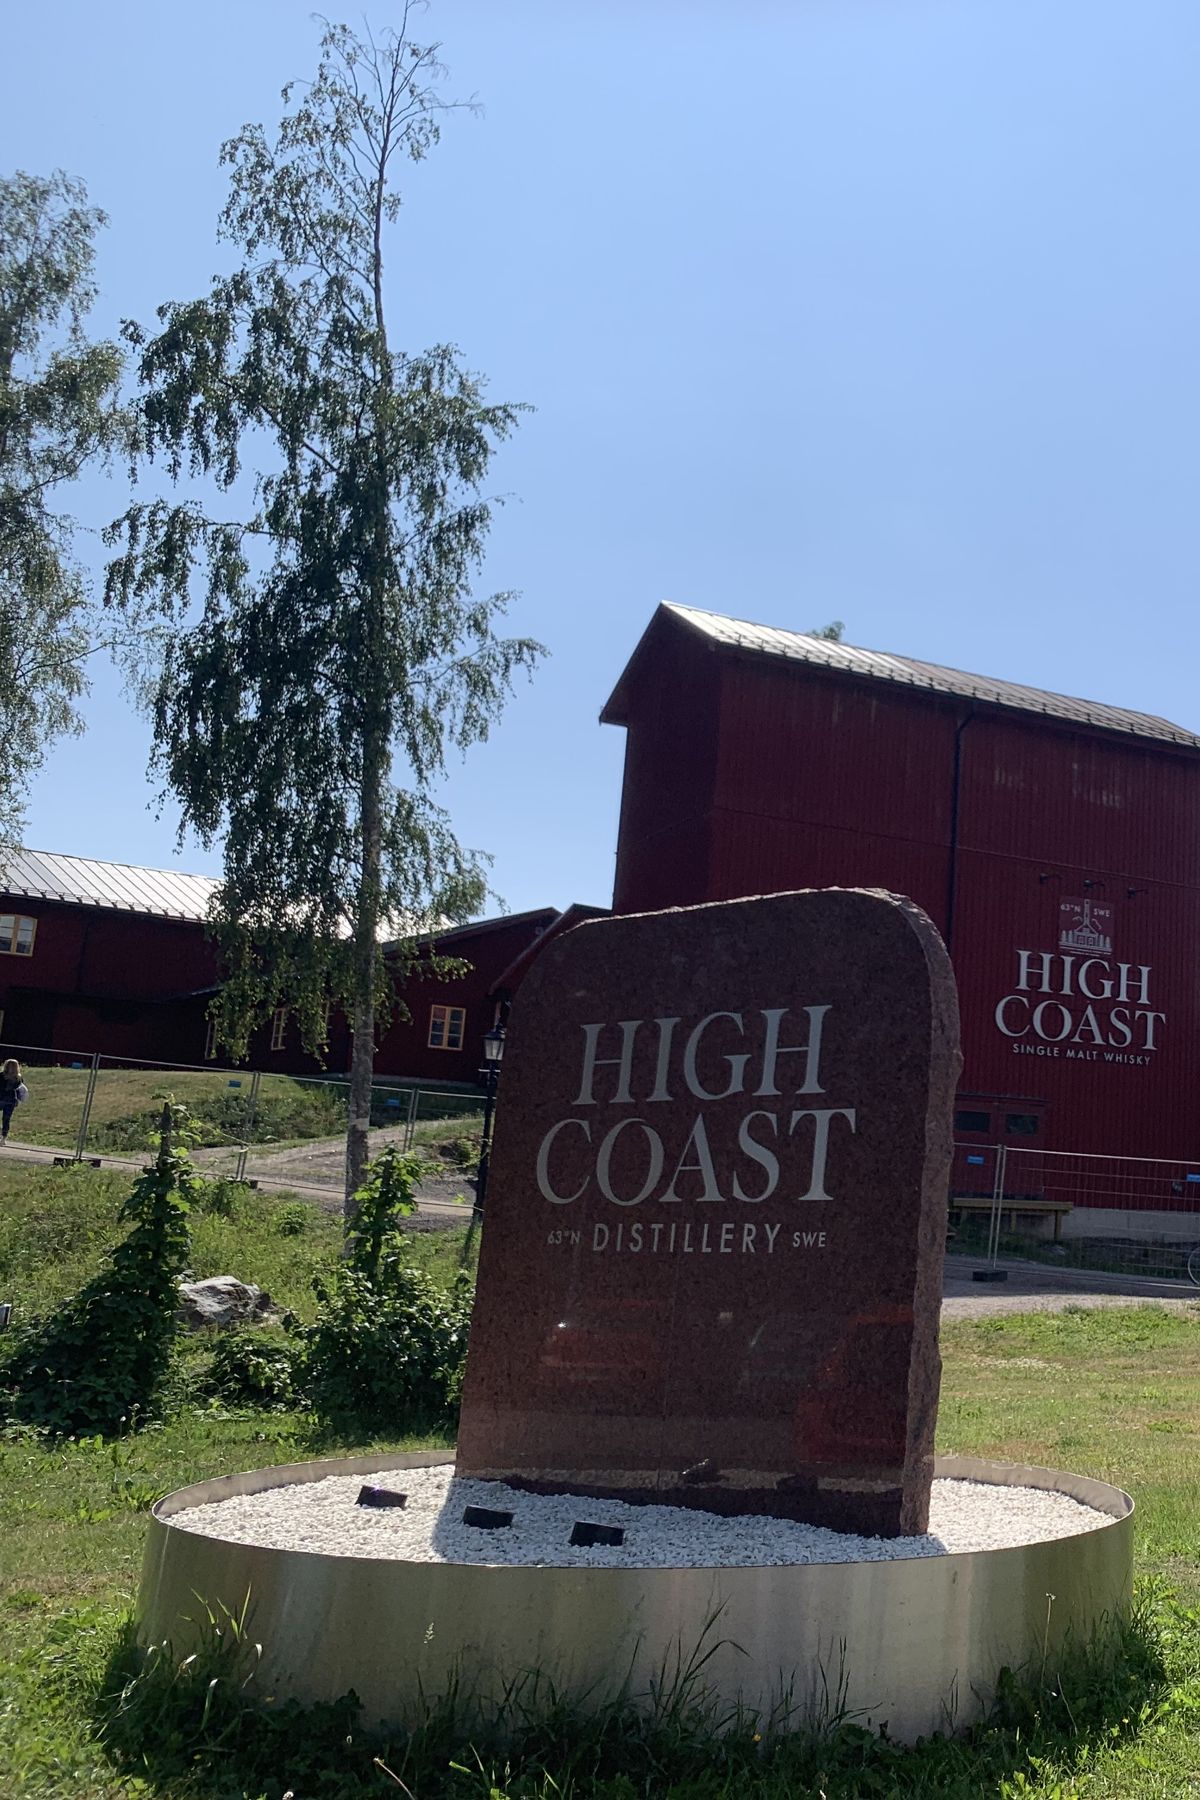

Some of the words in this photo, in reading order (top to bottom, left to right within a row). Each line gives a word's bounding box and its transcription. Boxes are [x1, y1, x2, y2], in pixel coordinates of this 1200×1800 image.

[1093, 908, 1110, 917] SWE
[1015, 949, 1152, 1005] HIGH
[995, 995, 1166, 1050] COAST
[571, 1004, 833, 1105] HIGH
[1012, 1043, 1060, 1057] SINGLE
[1066, 1049, 1098, 1060] MALT
[1104, 1052, 1151, 1066] WHISKY
[536, 1107, 857, 1206] COAST
[593, 1223, 783, 1253] DISTILLERY
[792, 1231, 827, 1248] SWE
